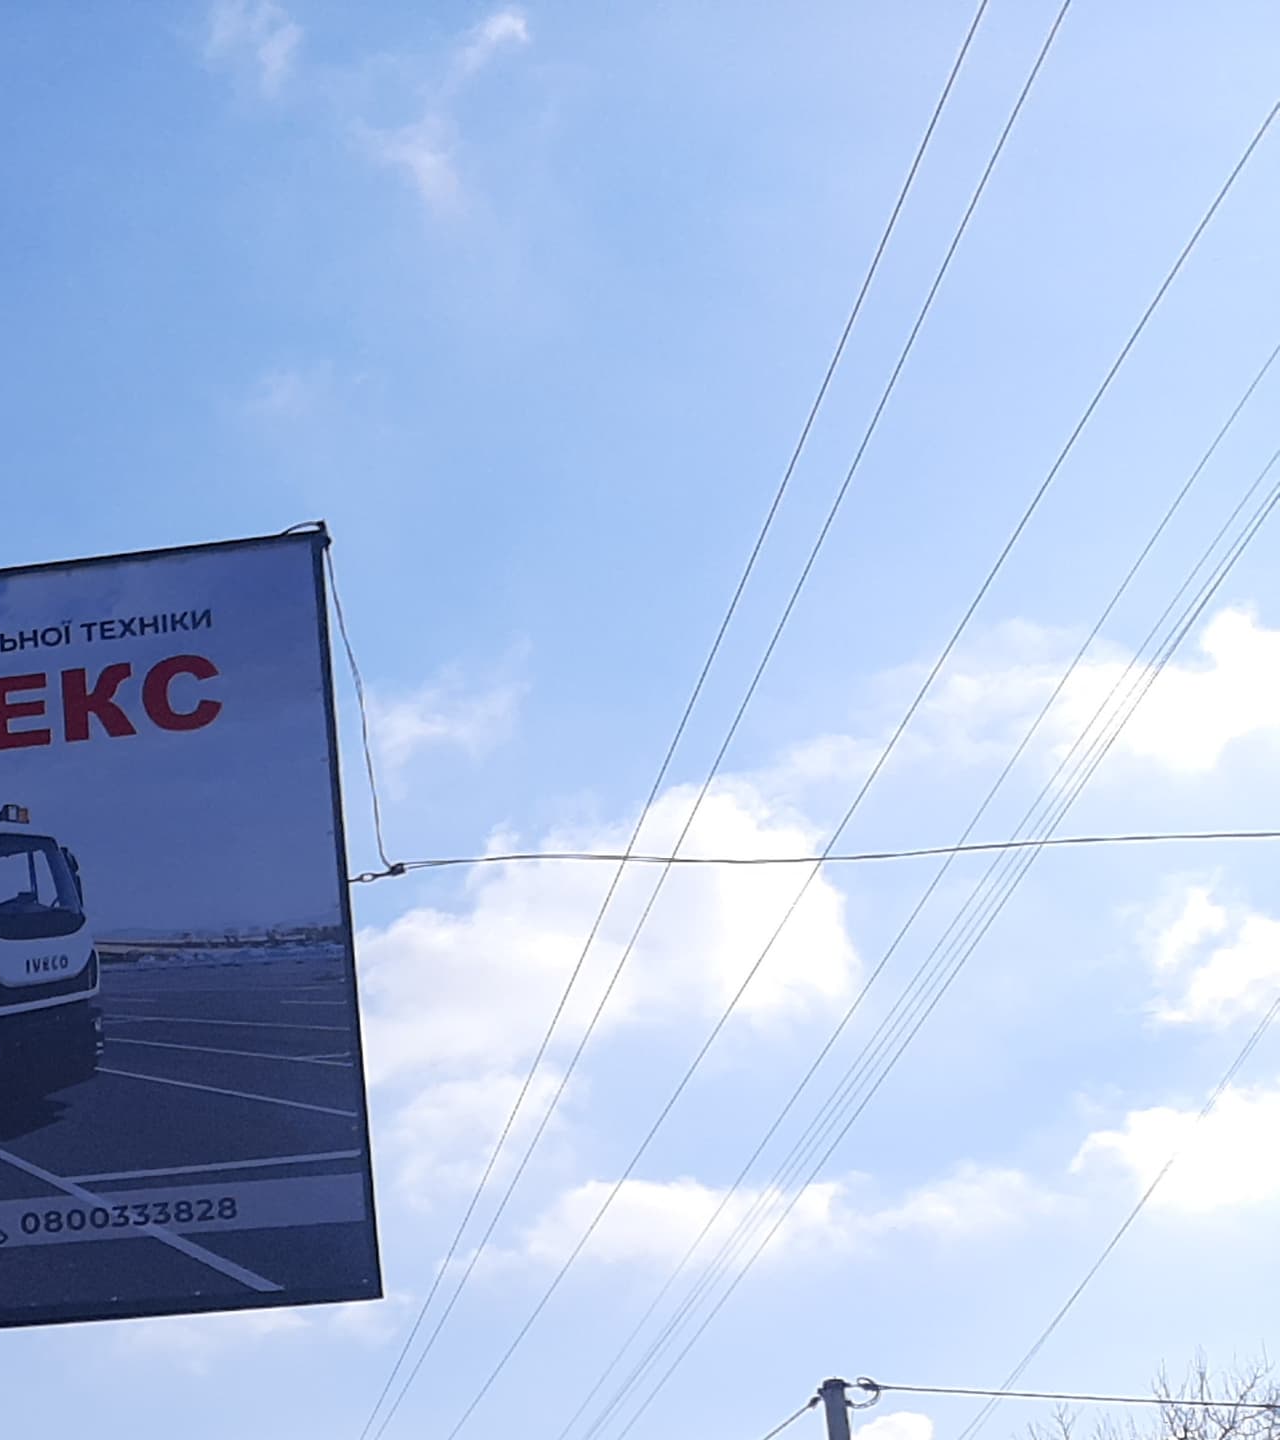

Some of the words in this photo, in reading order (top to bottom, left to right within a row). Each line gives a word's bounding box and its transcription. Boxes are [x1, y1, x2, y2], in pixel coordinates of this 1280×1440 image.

[80, 608, 215, 643] ТЕХНІКИ
[26, 954, 69, 974] IVECO
[19, 1196, 238, 1237] 0800333828
